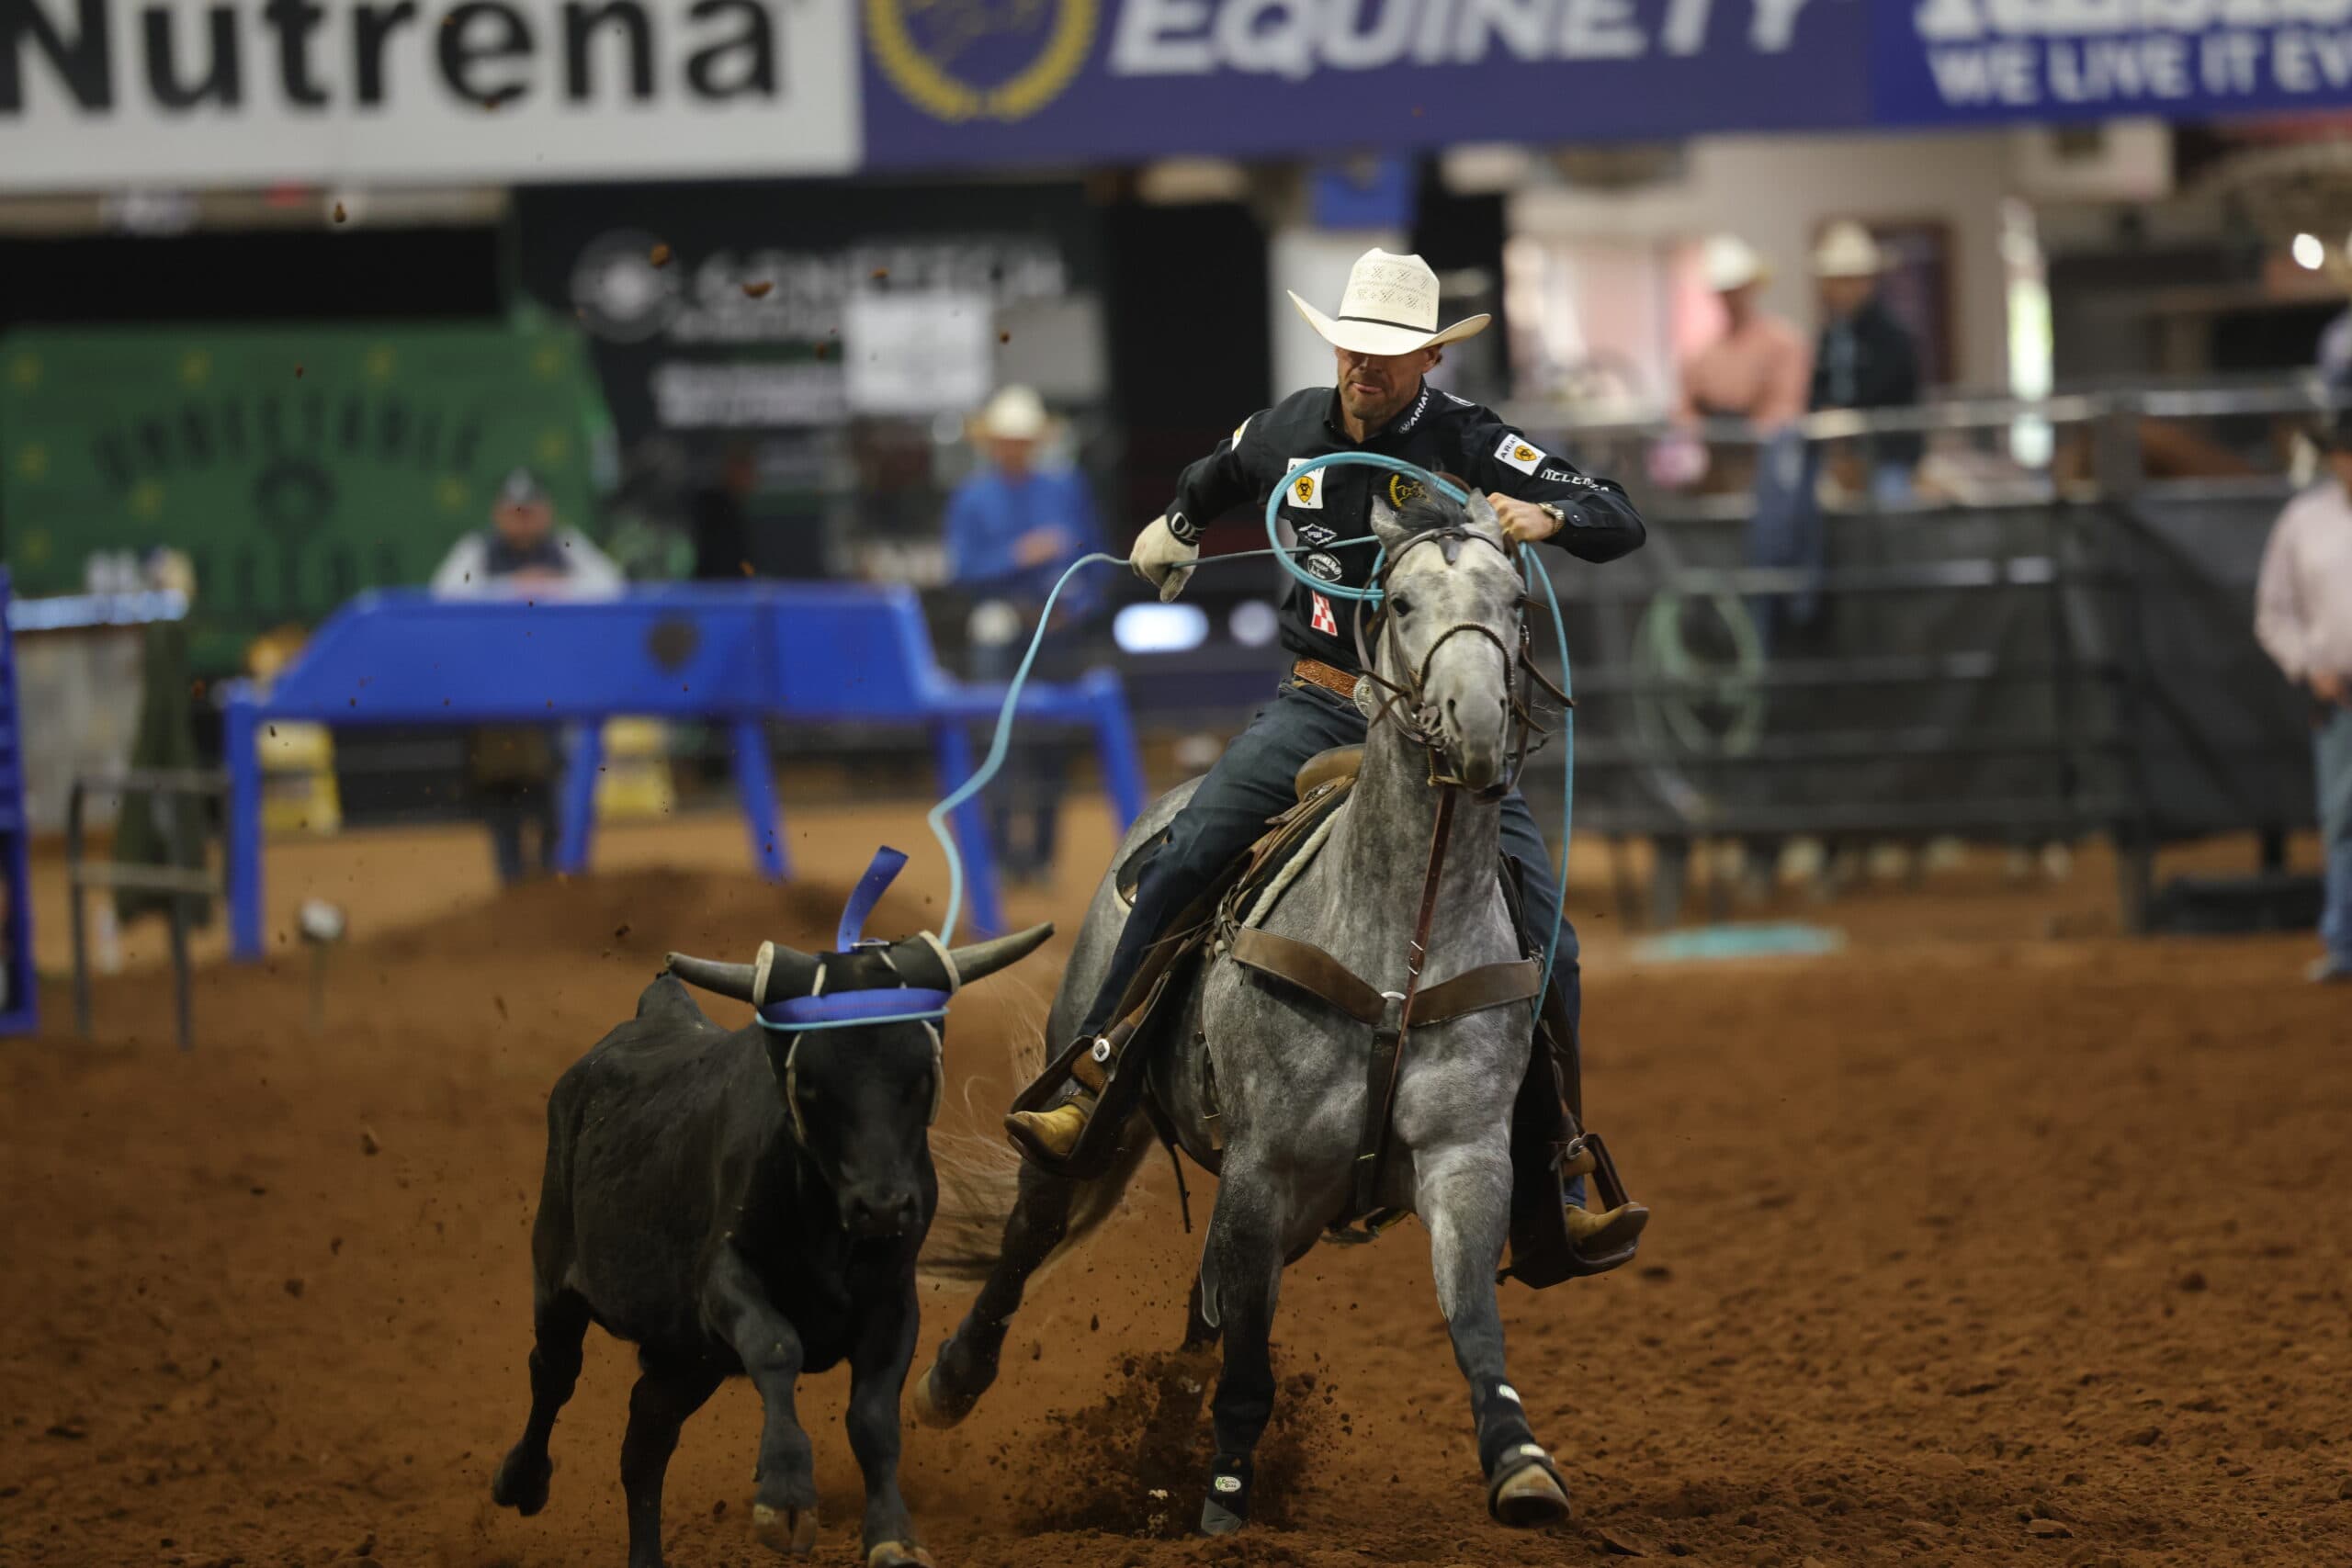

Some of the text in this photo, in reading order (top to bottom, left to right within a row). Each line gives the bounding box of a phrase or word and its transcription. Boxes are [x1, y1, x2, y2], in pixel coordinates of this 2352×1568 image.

[0, 0, 782, 118] Nutrena
[1928, 41, 2040, 106] WE
[2046, 36, 2192, 102] LIVE
[1410, 387, 1430, 427] ARIAT
